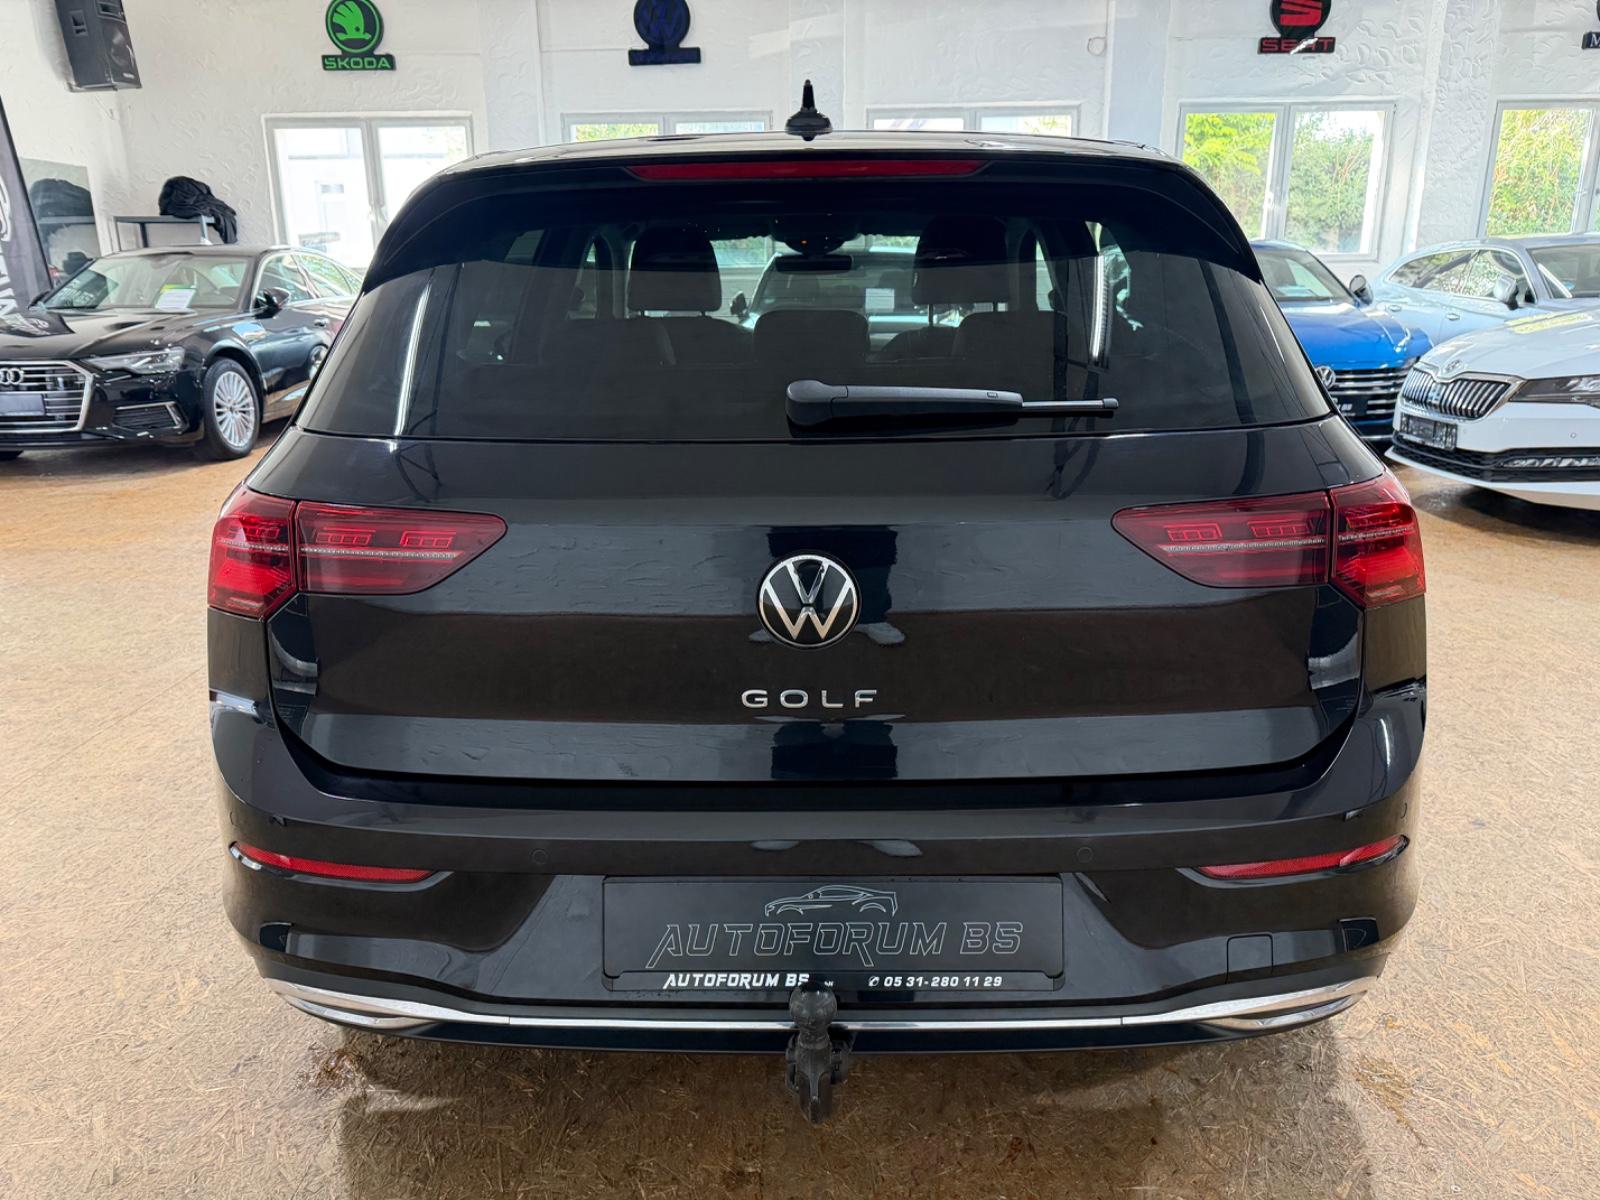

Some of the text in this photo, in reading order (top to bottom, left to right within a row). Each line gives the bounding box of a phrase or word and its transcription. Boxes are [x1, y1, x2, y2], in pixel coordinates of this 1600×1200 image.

[741, 689, 878, 709] GOLF
[645, 921, 1024, 969] AUTOFORUM BS
[662, 973, 780, 989] AUTOFORUM
[883, 976, 903, 987] 05
[963, 976, 980, 987] 11
[983, 976, 1003, 987] 29
